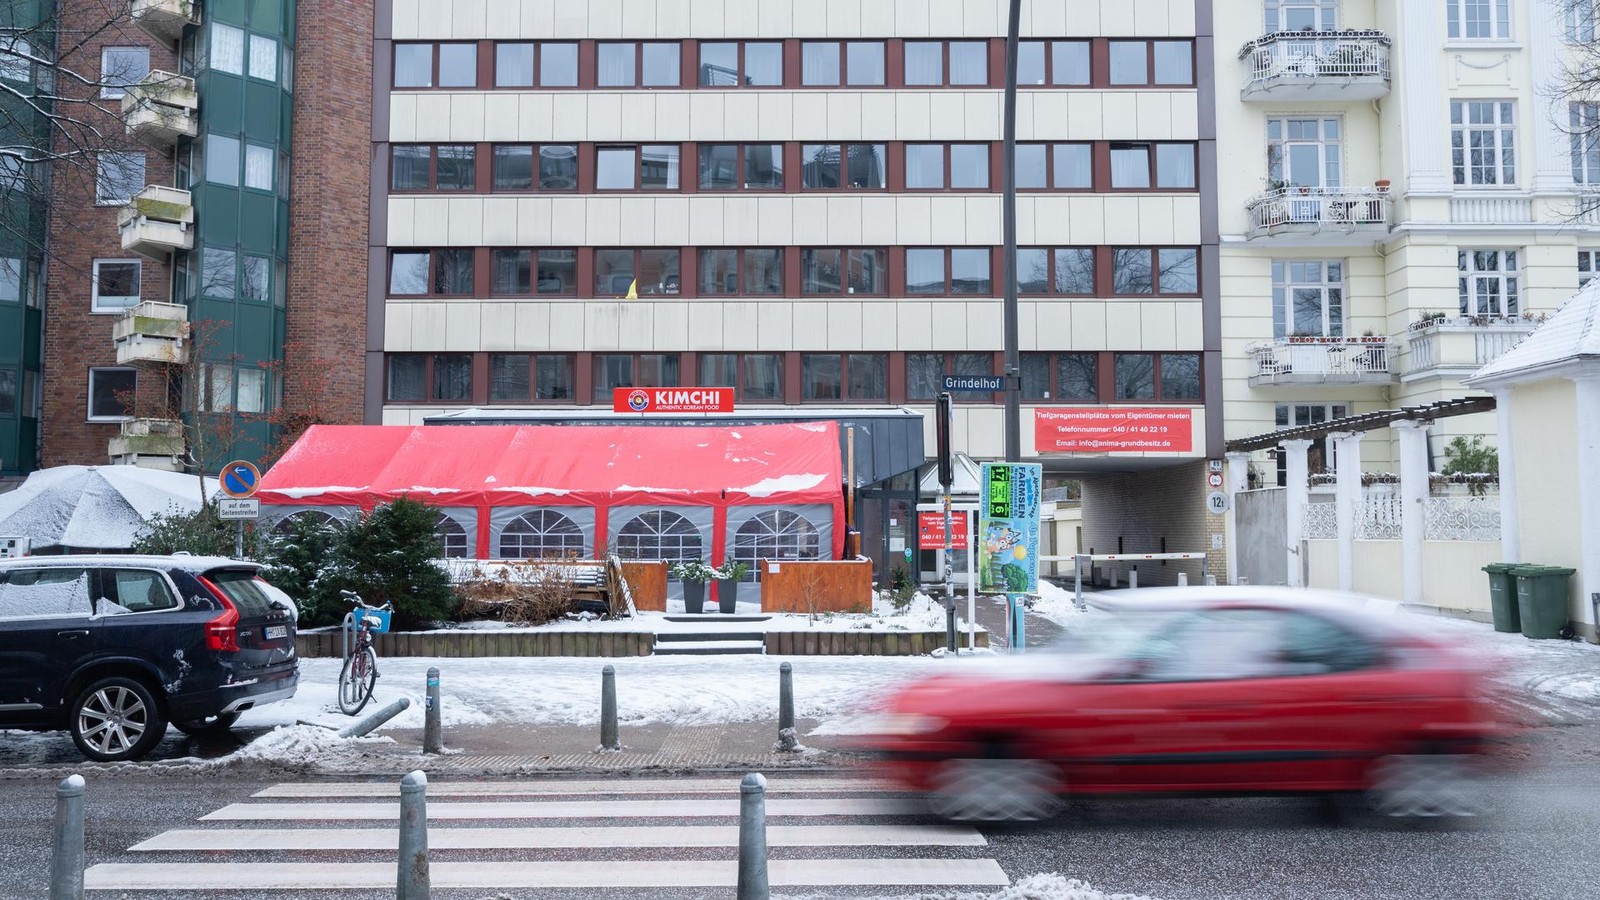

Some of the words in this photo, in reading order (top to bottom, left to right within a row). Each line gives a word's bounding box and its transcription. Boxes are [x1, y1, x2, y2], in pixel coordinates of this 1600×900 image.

[945, 377, 1000, 389] Grindelhof
[655, 391, 720, 405] KIMCHI
[1036, 412, 1110, 420] Tiefgaragenstellplätze
[1127, 412, 1166, 420] Eigentümer
[1078, 440, 1171, 448] info@anima-grundbesitz.de
[996, 467, 1004, 481] 17
[1018, 466, 1026, 518] FARMSEN
[996, 506, 1004, 514] 6
